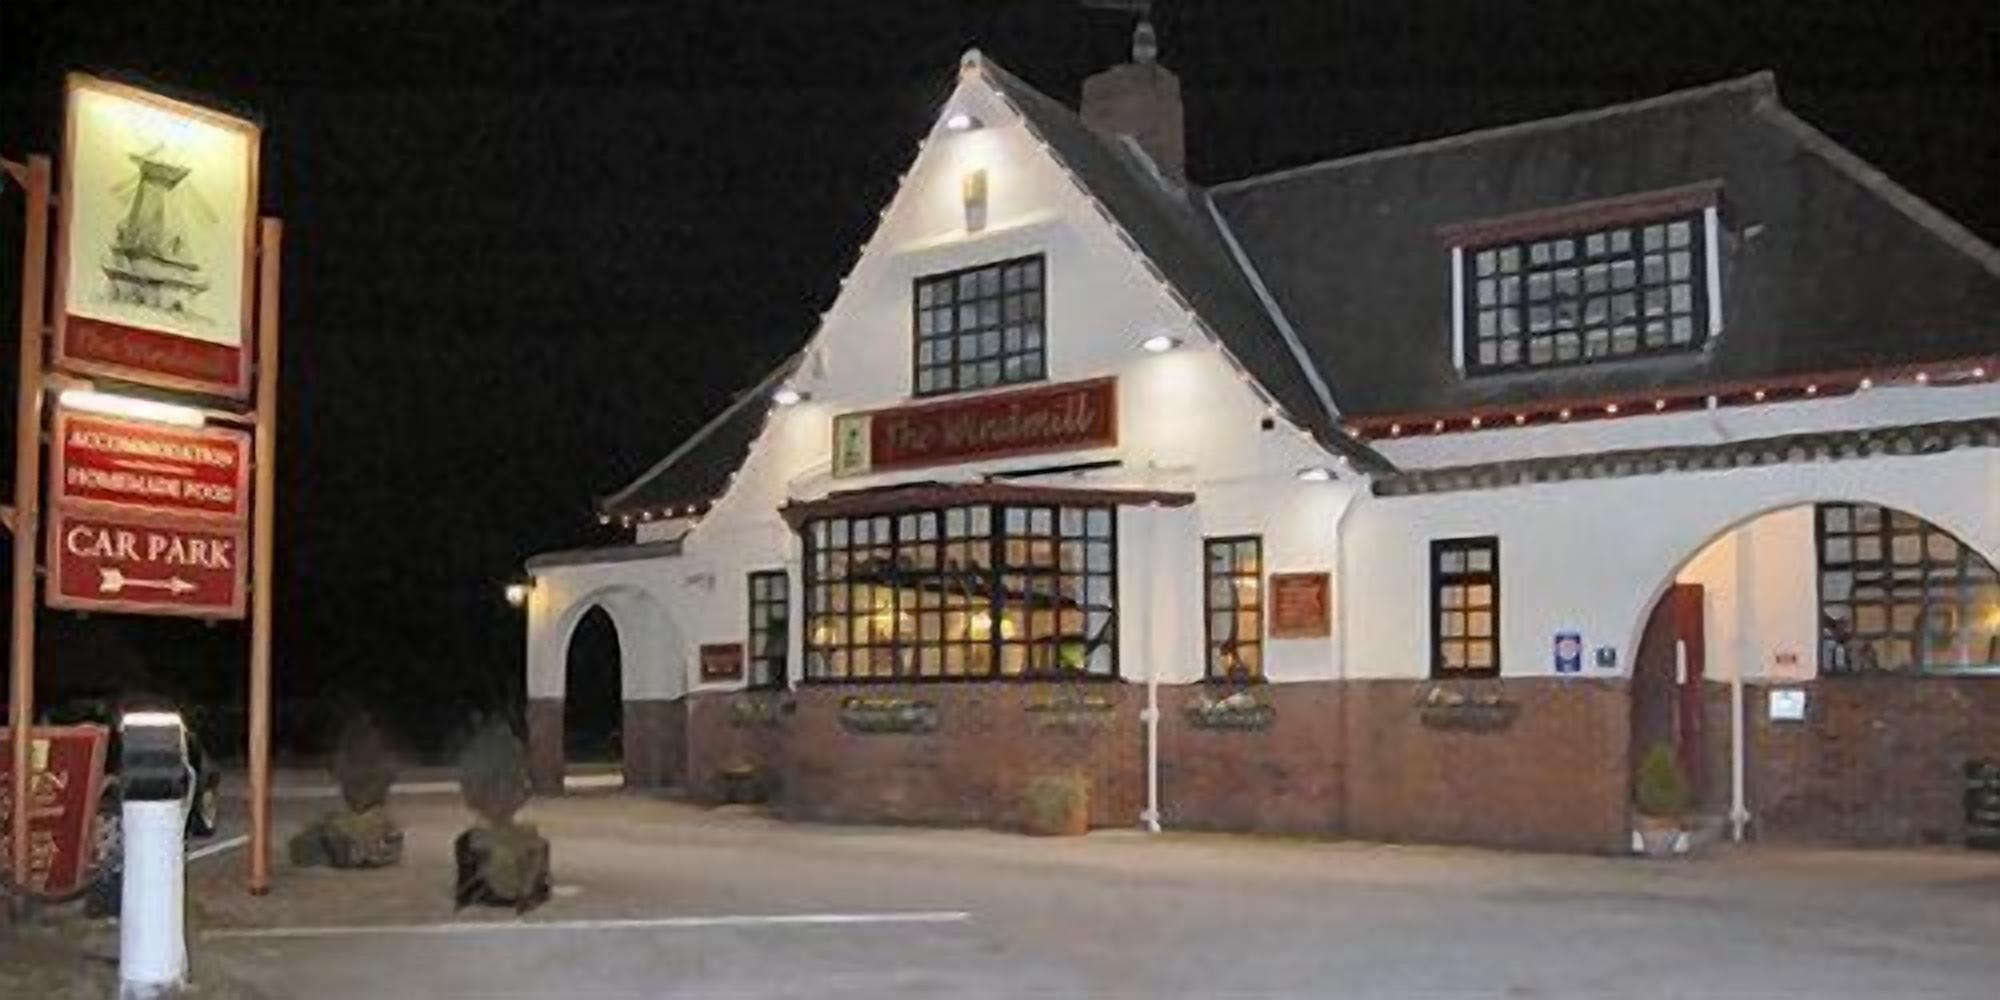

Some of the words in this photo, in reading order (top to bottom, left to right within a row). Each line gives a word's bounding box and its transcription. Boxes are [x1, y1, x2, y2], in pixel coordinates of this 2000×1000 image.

[183, 479, 234, 505] FOOD
[67, 525, 140, 562] CAR
[147, 533, 232, 570] PARK
